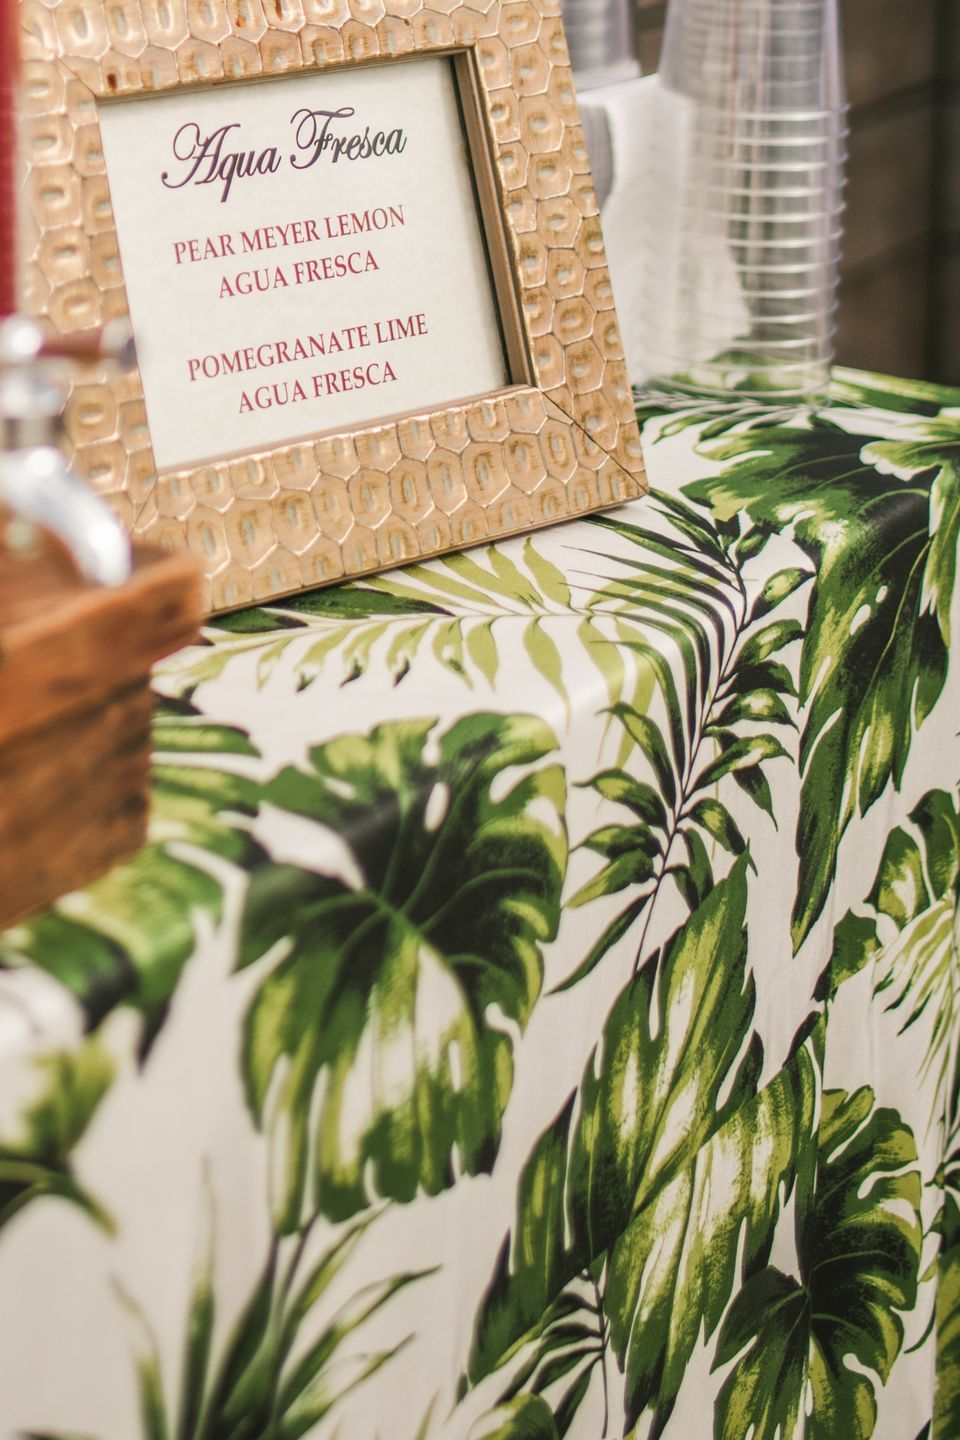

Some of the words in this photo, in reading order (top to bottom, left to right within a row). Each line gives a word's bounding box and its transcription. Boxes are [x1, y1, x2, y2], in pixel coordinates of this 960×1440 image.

[290, 107, 407, 169] Fresca
[174, 234, 236, 264] PEAR
[240, 220, 320, 253] MEYER
[324, 205, 404, 238] LEMON
[220, 267, 289, 298] AGUA
[293, 250, 379, 284] FRESCA
[188, 325, 371, 382] POMEGRANATE
[374, 314, 428, 343] LIME
[239, 380, 308, 413] AGUA
[312, 361, 397, 397] FRESCA
